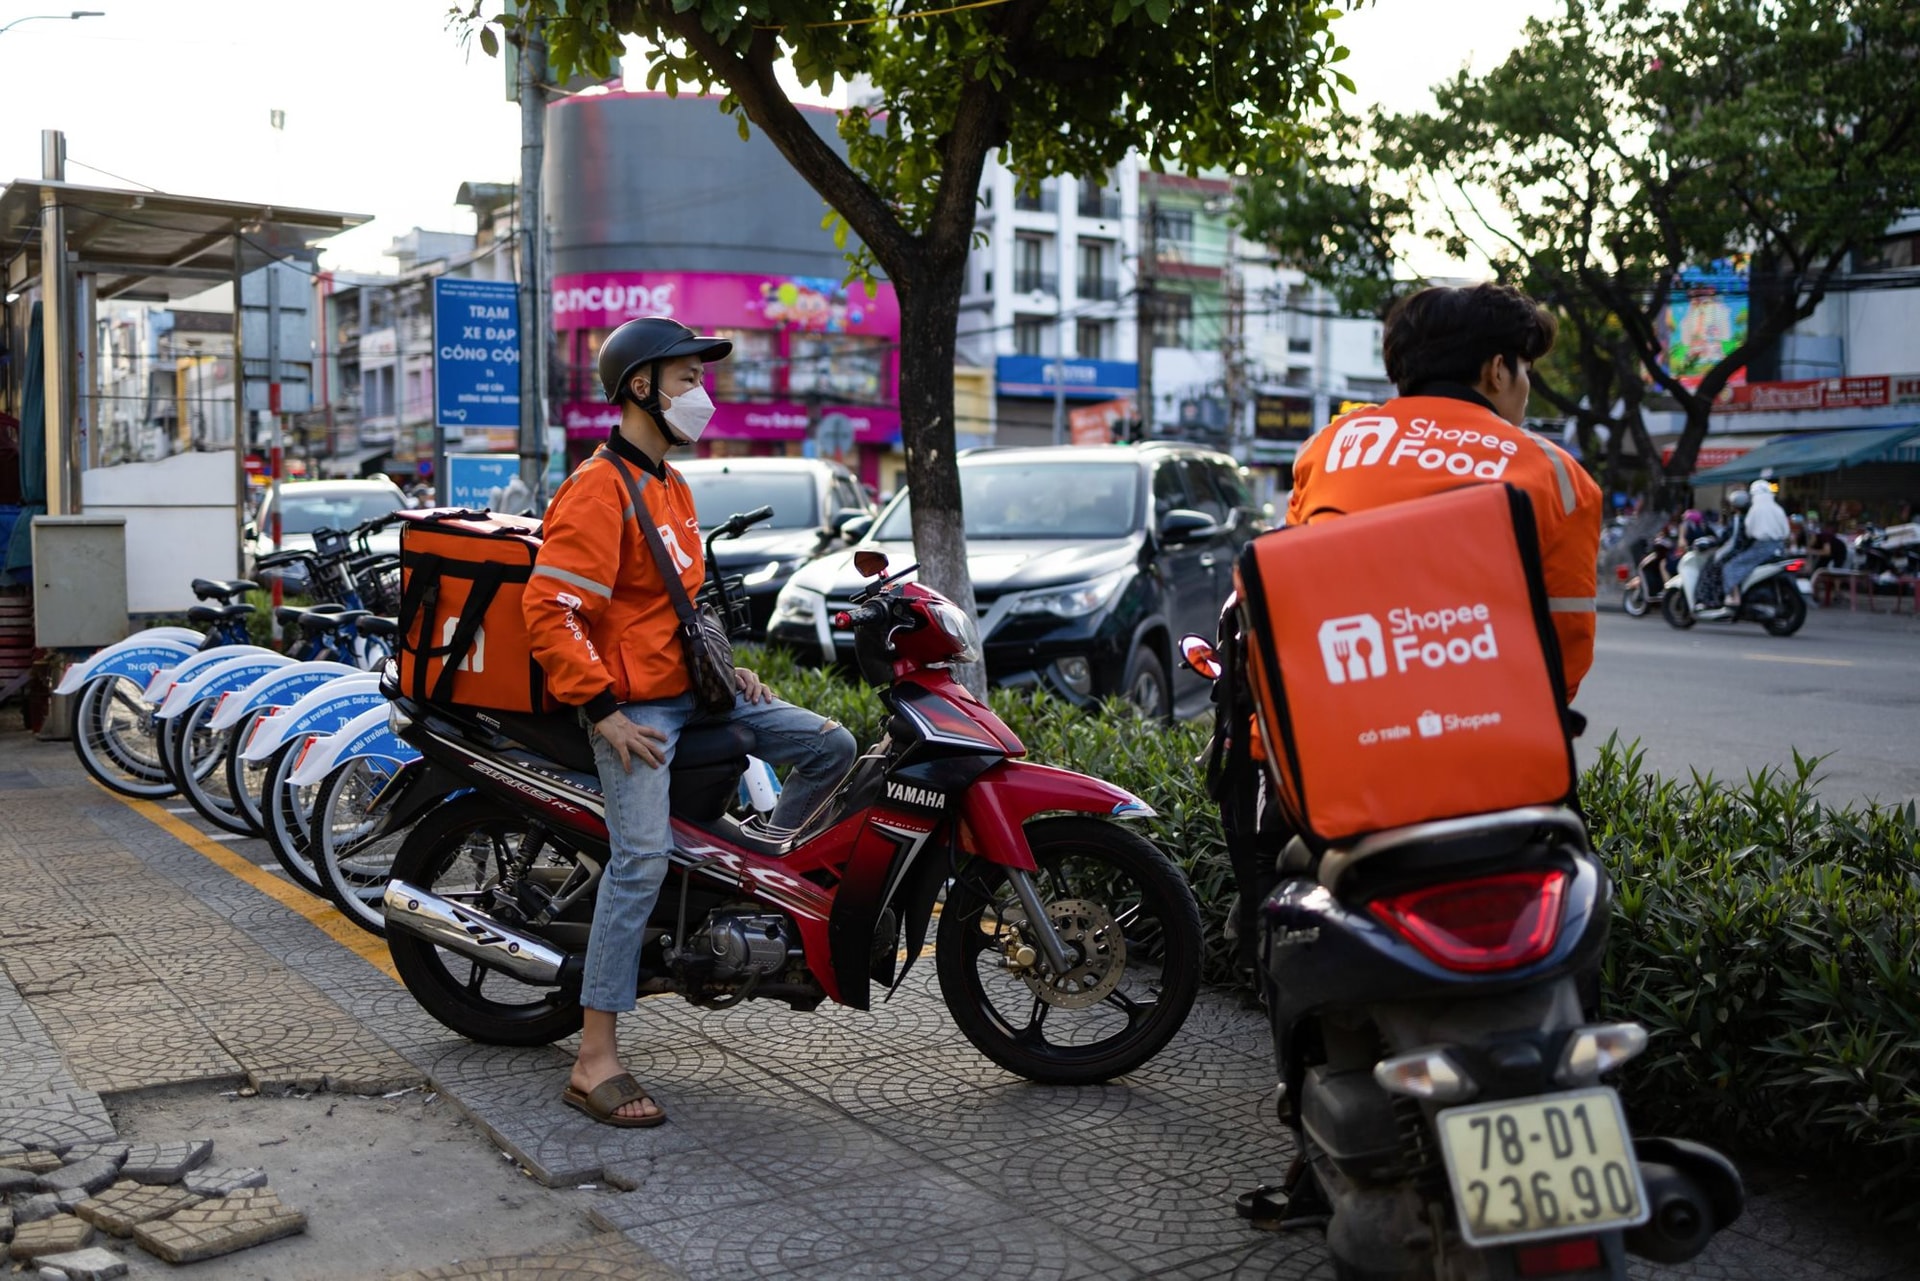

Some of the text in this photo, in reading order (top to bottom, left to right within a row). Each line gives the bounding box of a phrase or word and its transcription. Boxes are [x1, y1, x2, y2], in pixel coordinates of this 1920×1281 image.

[469, 305, 510, 322] TRẠM
[463, 326, 517, 344] XE ĐẠP
[440, 344, 488, 361] CÔNG
[1405, 418, 1519, 456] Shopee
[1388, 439, 1508, 480] Food
[1388, 603, 1490, 634] Shopee
[1393, 624, 1498, 673] Food
[1443, 711, 1502, 731] Shopee
[468, 761, 582, 814] SIRIUS RC
[887, 781, 946, 809] YAMAHA
[1469, 1104, 1597, 1171] 78-D1
[1467, 1161, 1634, 1229] 236.90
